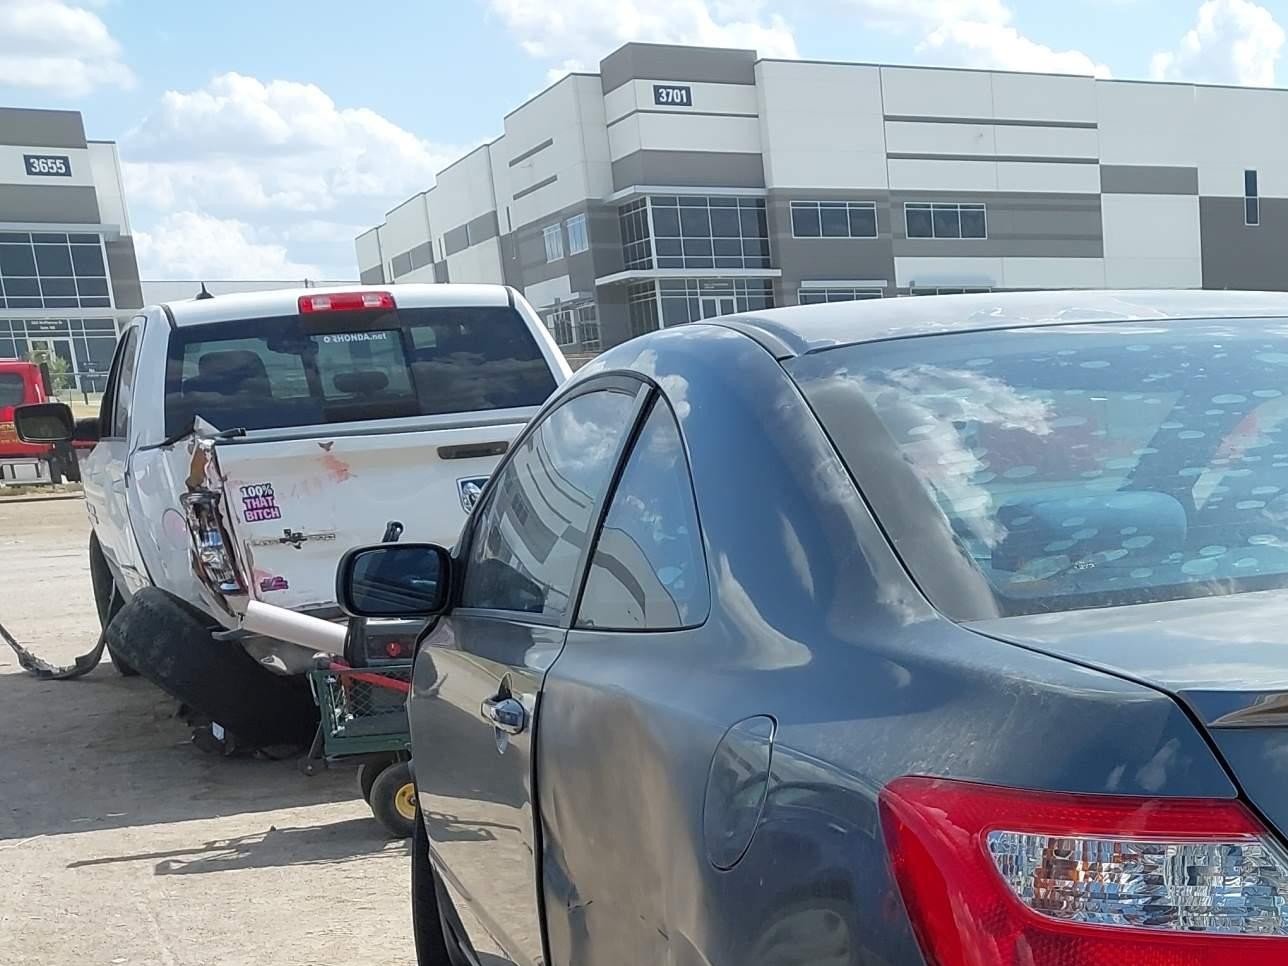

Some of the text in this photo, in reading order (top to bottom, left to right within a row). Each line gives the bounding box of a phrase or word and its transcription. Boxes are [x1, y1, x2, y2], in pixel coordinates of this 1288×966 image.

[658, 88, 688, 104] 3701
[30, 158, 66, 174] 3655
[241, 483, 273, 498] 100%
[244, 496, 274, 509] THAT
[245, 507, 280, 521] BITCH
